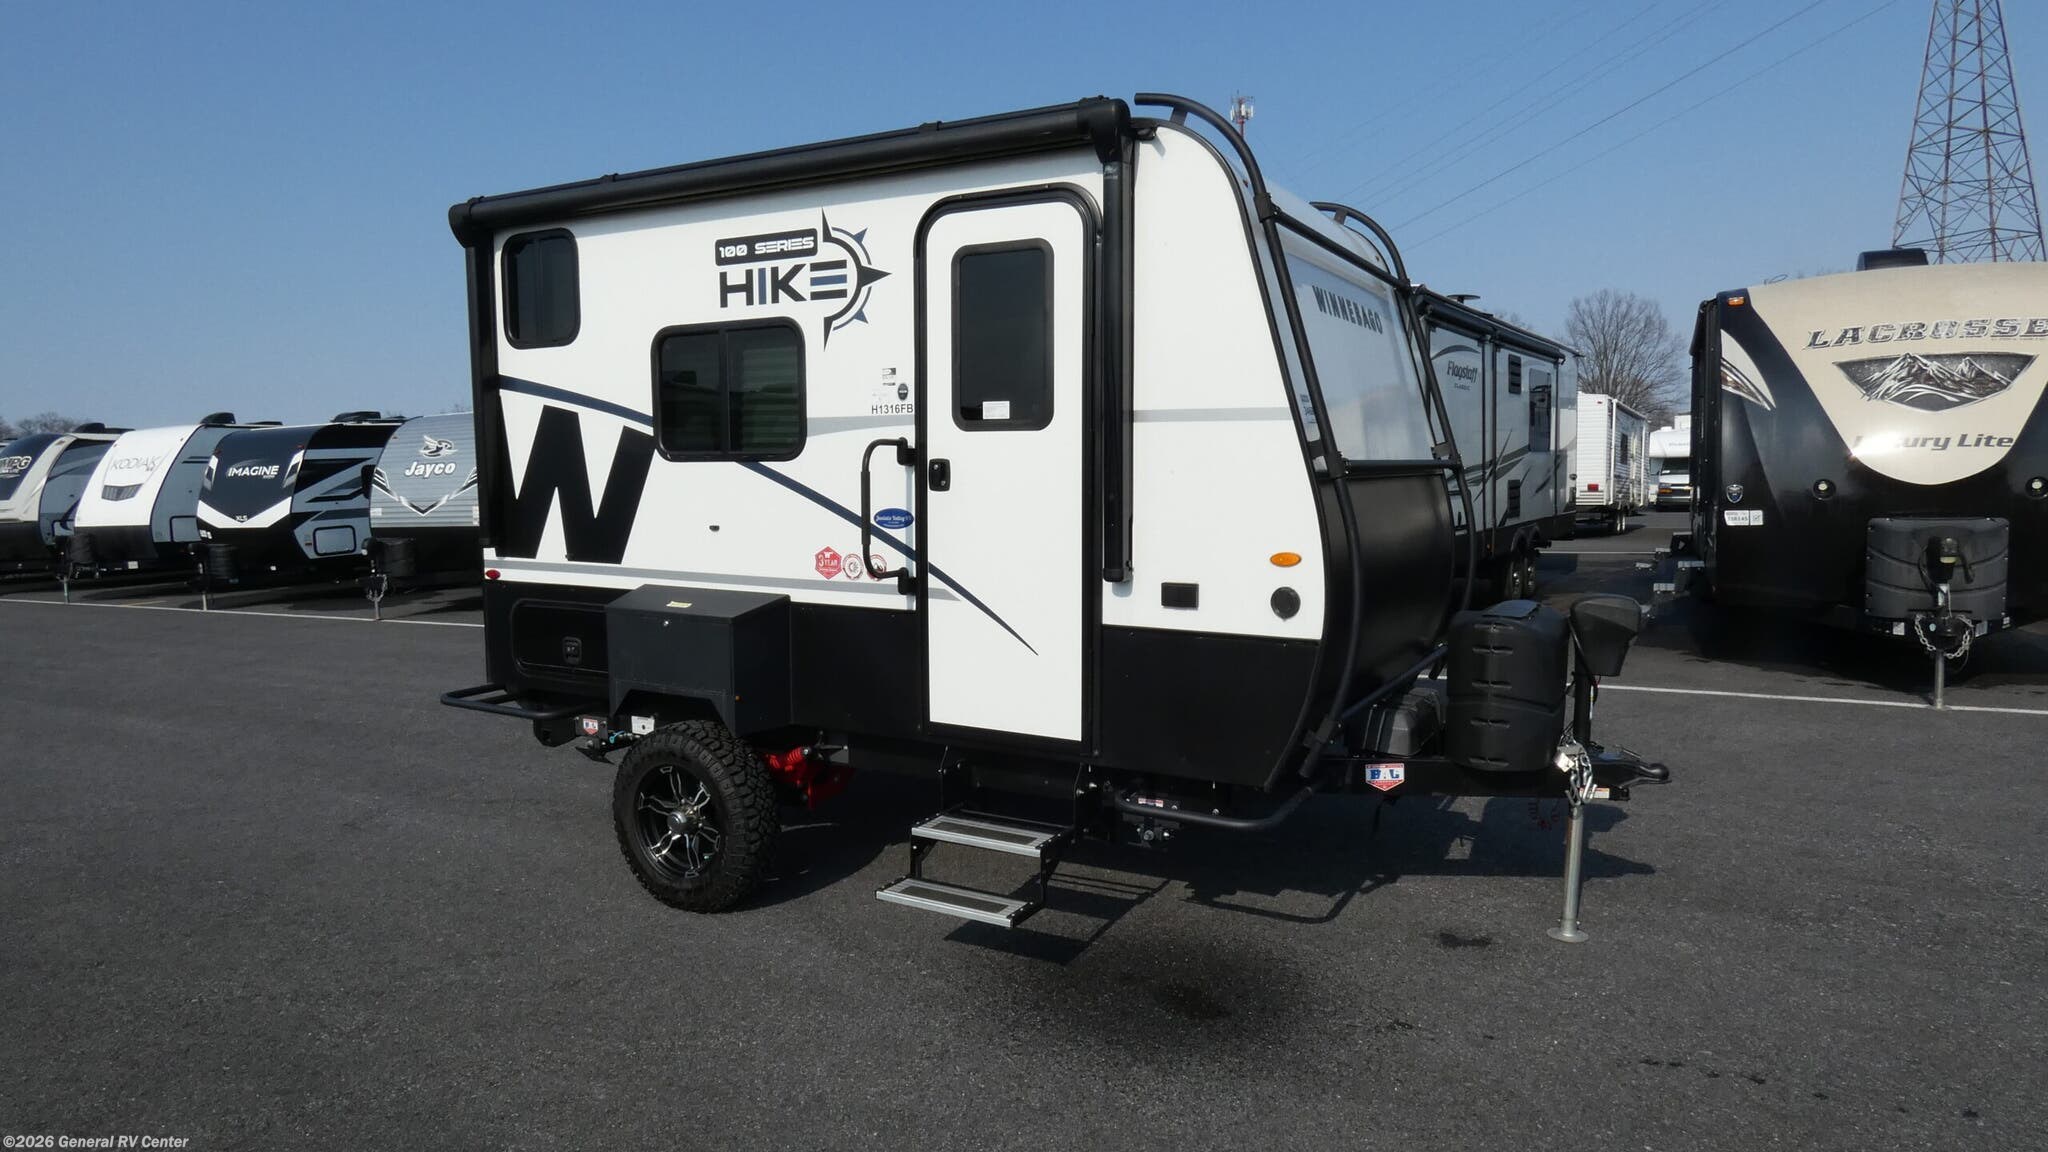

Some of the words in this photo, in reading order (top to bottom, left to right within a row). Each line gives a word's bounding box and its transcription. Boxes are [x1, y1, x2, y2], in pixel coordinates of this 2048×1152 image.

[719, 244, 748, 258] 100
[754, 236, 815, 255] SERIES
[719, 259, 848, 309] HIKE
[1311, 285, 1383, 335] WINNEBAGO
[1801, 318, 2048, 350] LACROSSE
[1447, 360, 1478, 383] Flagstaff
[871, 403, 914, 415] H1316FB
[1957, 433, 2014, 448] Lite
[228, 465, 280, 477] IMAGINE
[404, 461, 456, 479] Jayco
